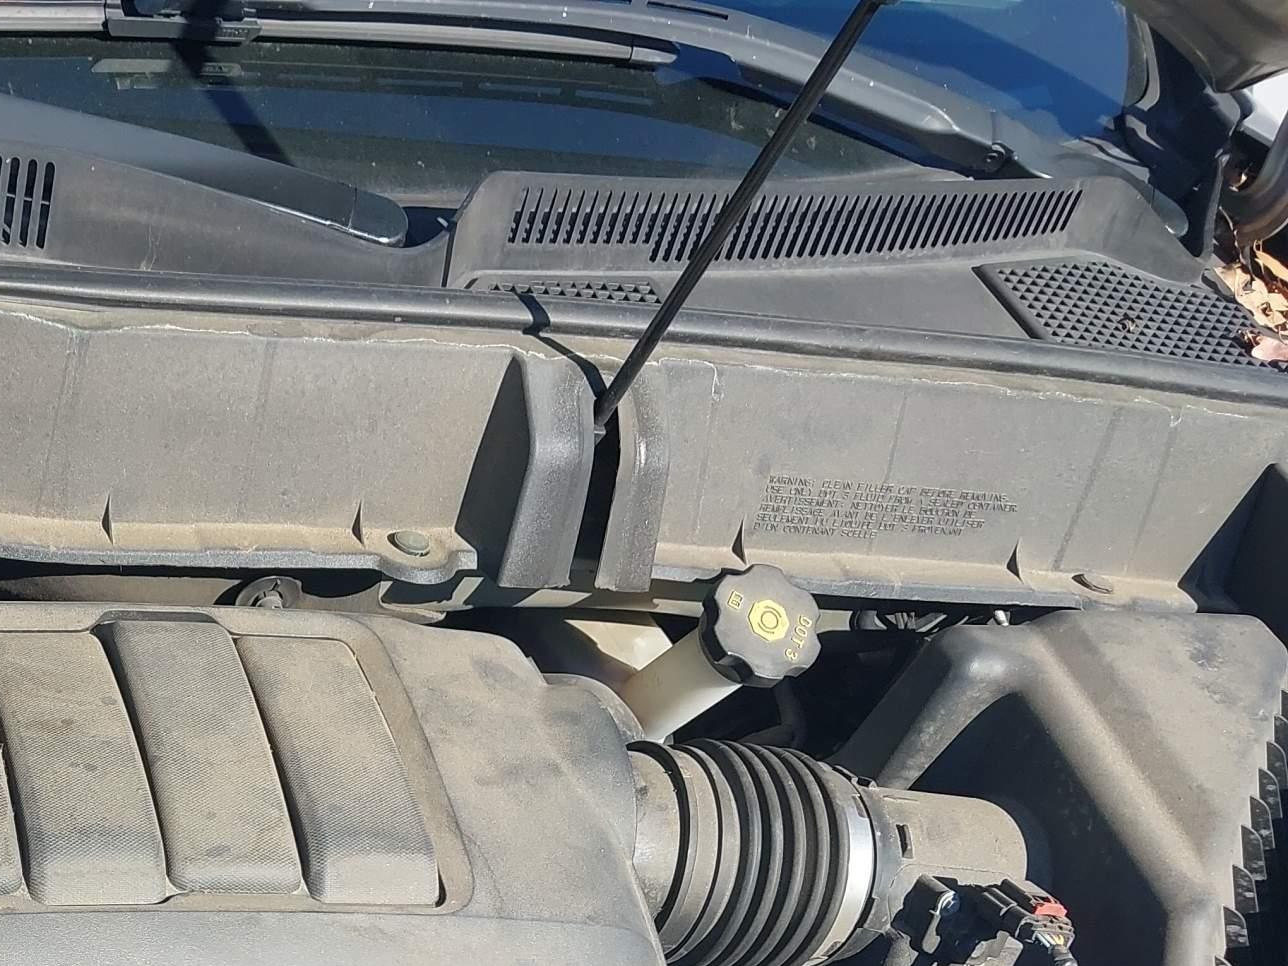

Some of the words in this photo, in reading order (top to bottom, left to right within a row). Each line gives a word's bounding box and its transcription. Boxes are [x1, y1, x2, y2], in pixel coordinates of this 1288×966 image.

[765, 484, 785, 495] USE
[789, 487, 813, 497] ONLY
[818, 489, 837, 499] DOT
[854, 492, 885, 503] FLUID
[888, 494, 913, 505] FROM
[928, 498, 963, 509] SEALED
[822, 479, 852, 490] CLEAN
[857, 482, 895, 494] FILLER
[920, 487, 956, 498] BEFORE
[902, 504, 915, 514] LE
[962, 509, 976, 519] DE
[755, 512, 810, 526] SEULEMENT
[878, 521, 897, 531] DOT
[781, 525, 836, 537] CONTENANT
[791, 615, 813, 649] DOT
[784, 648, 799, 661] 3
